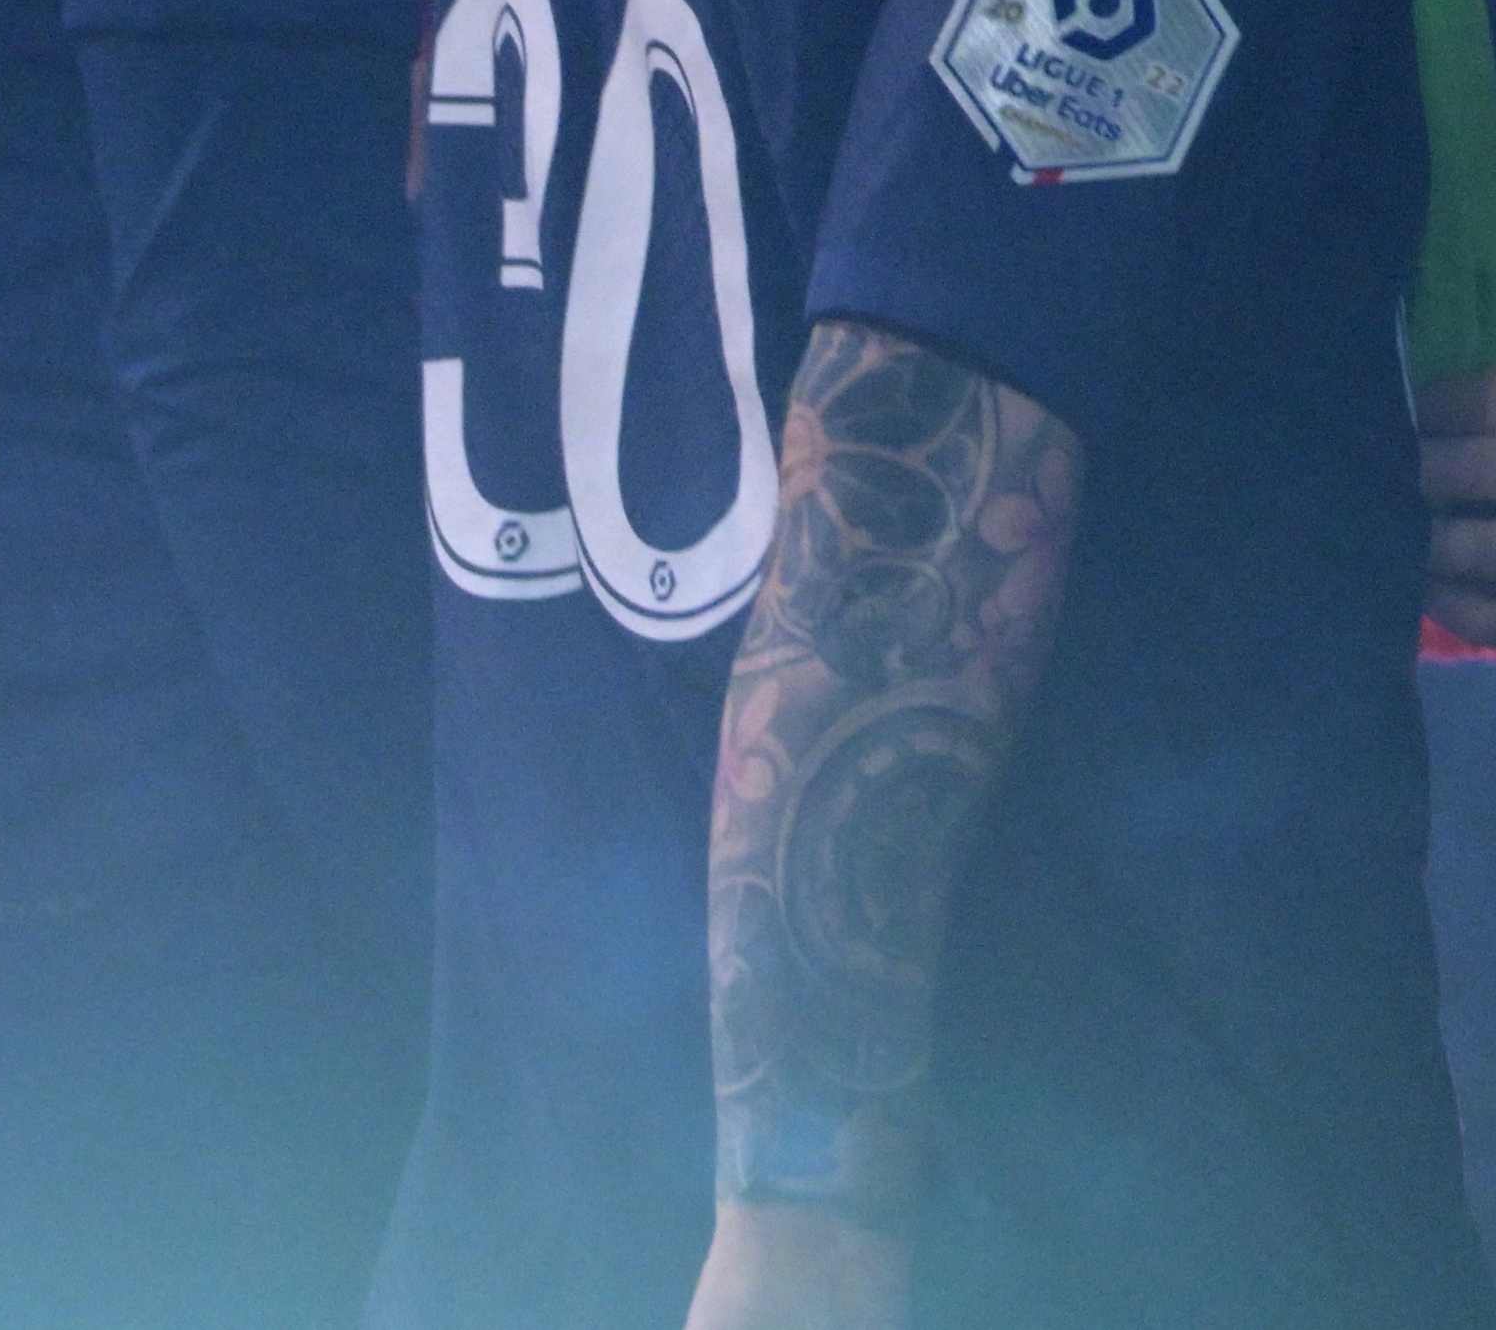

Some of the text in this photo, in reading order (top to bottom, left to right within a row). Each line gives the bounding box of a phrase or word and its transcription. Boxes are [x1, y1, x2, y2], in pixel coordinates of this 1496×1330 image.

[989, 63, 1055, 110] Uber
[1057, 94, 1123, 142] Eats
[1015, 42, 1105, 97] LIGUE
